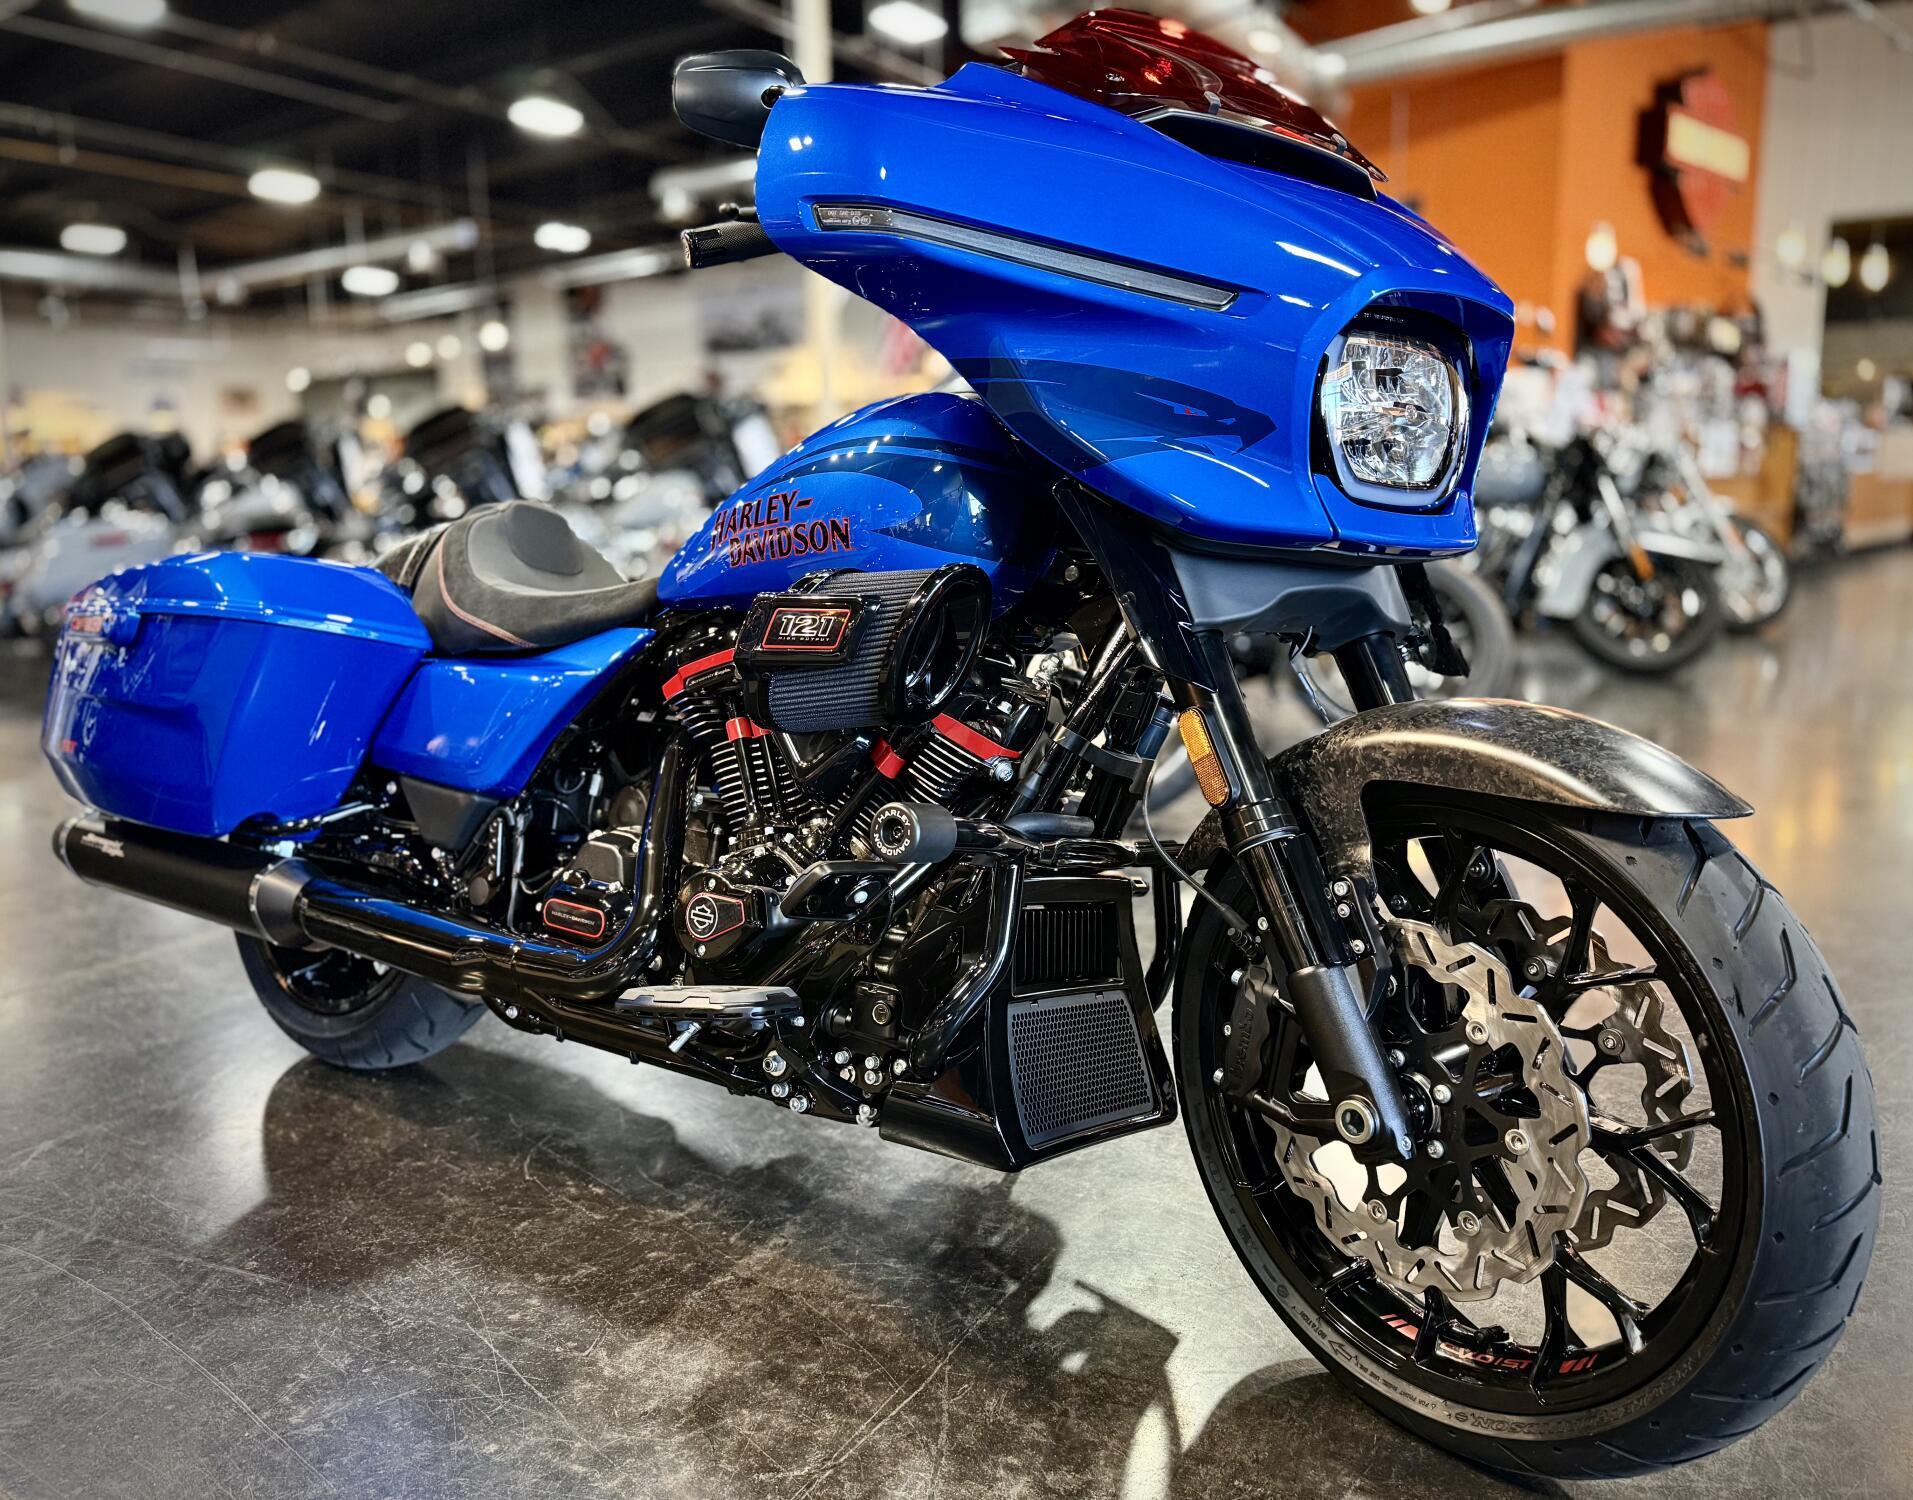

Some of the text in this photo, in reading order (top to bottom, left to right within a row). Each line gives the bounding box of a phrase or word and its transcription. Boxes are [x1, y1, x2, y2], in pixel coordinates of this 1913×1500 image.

[710, 490, 814, 552] HARLEY-
[729, 517, 852, 568] DAVIDSON
[780, 615, 835, 637] 121
[873, 809, 911, 856] HARLEY DAVIDSON
